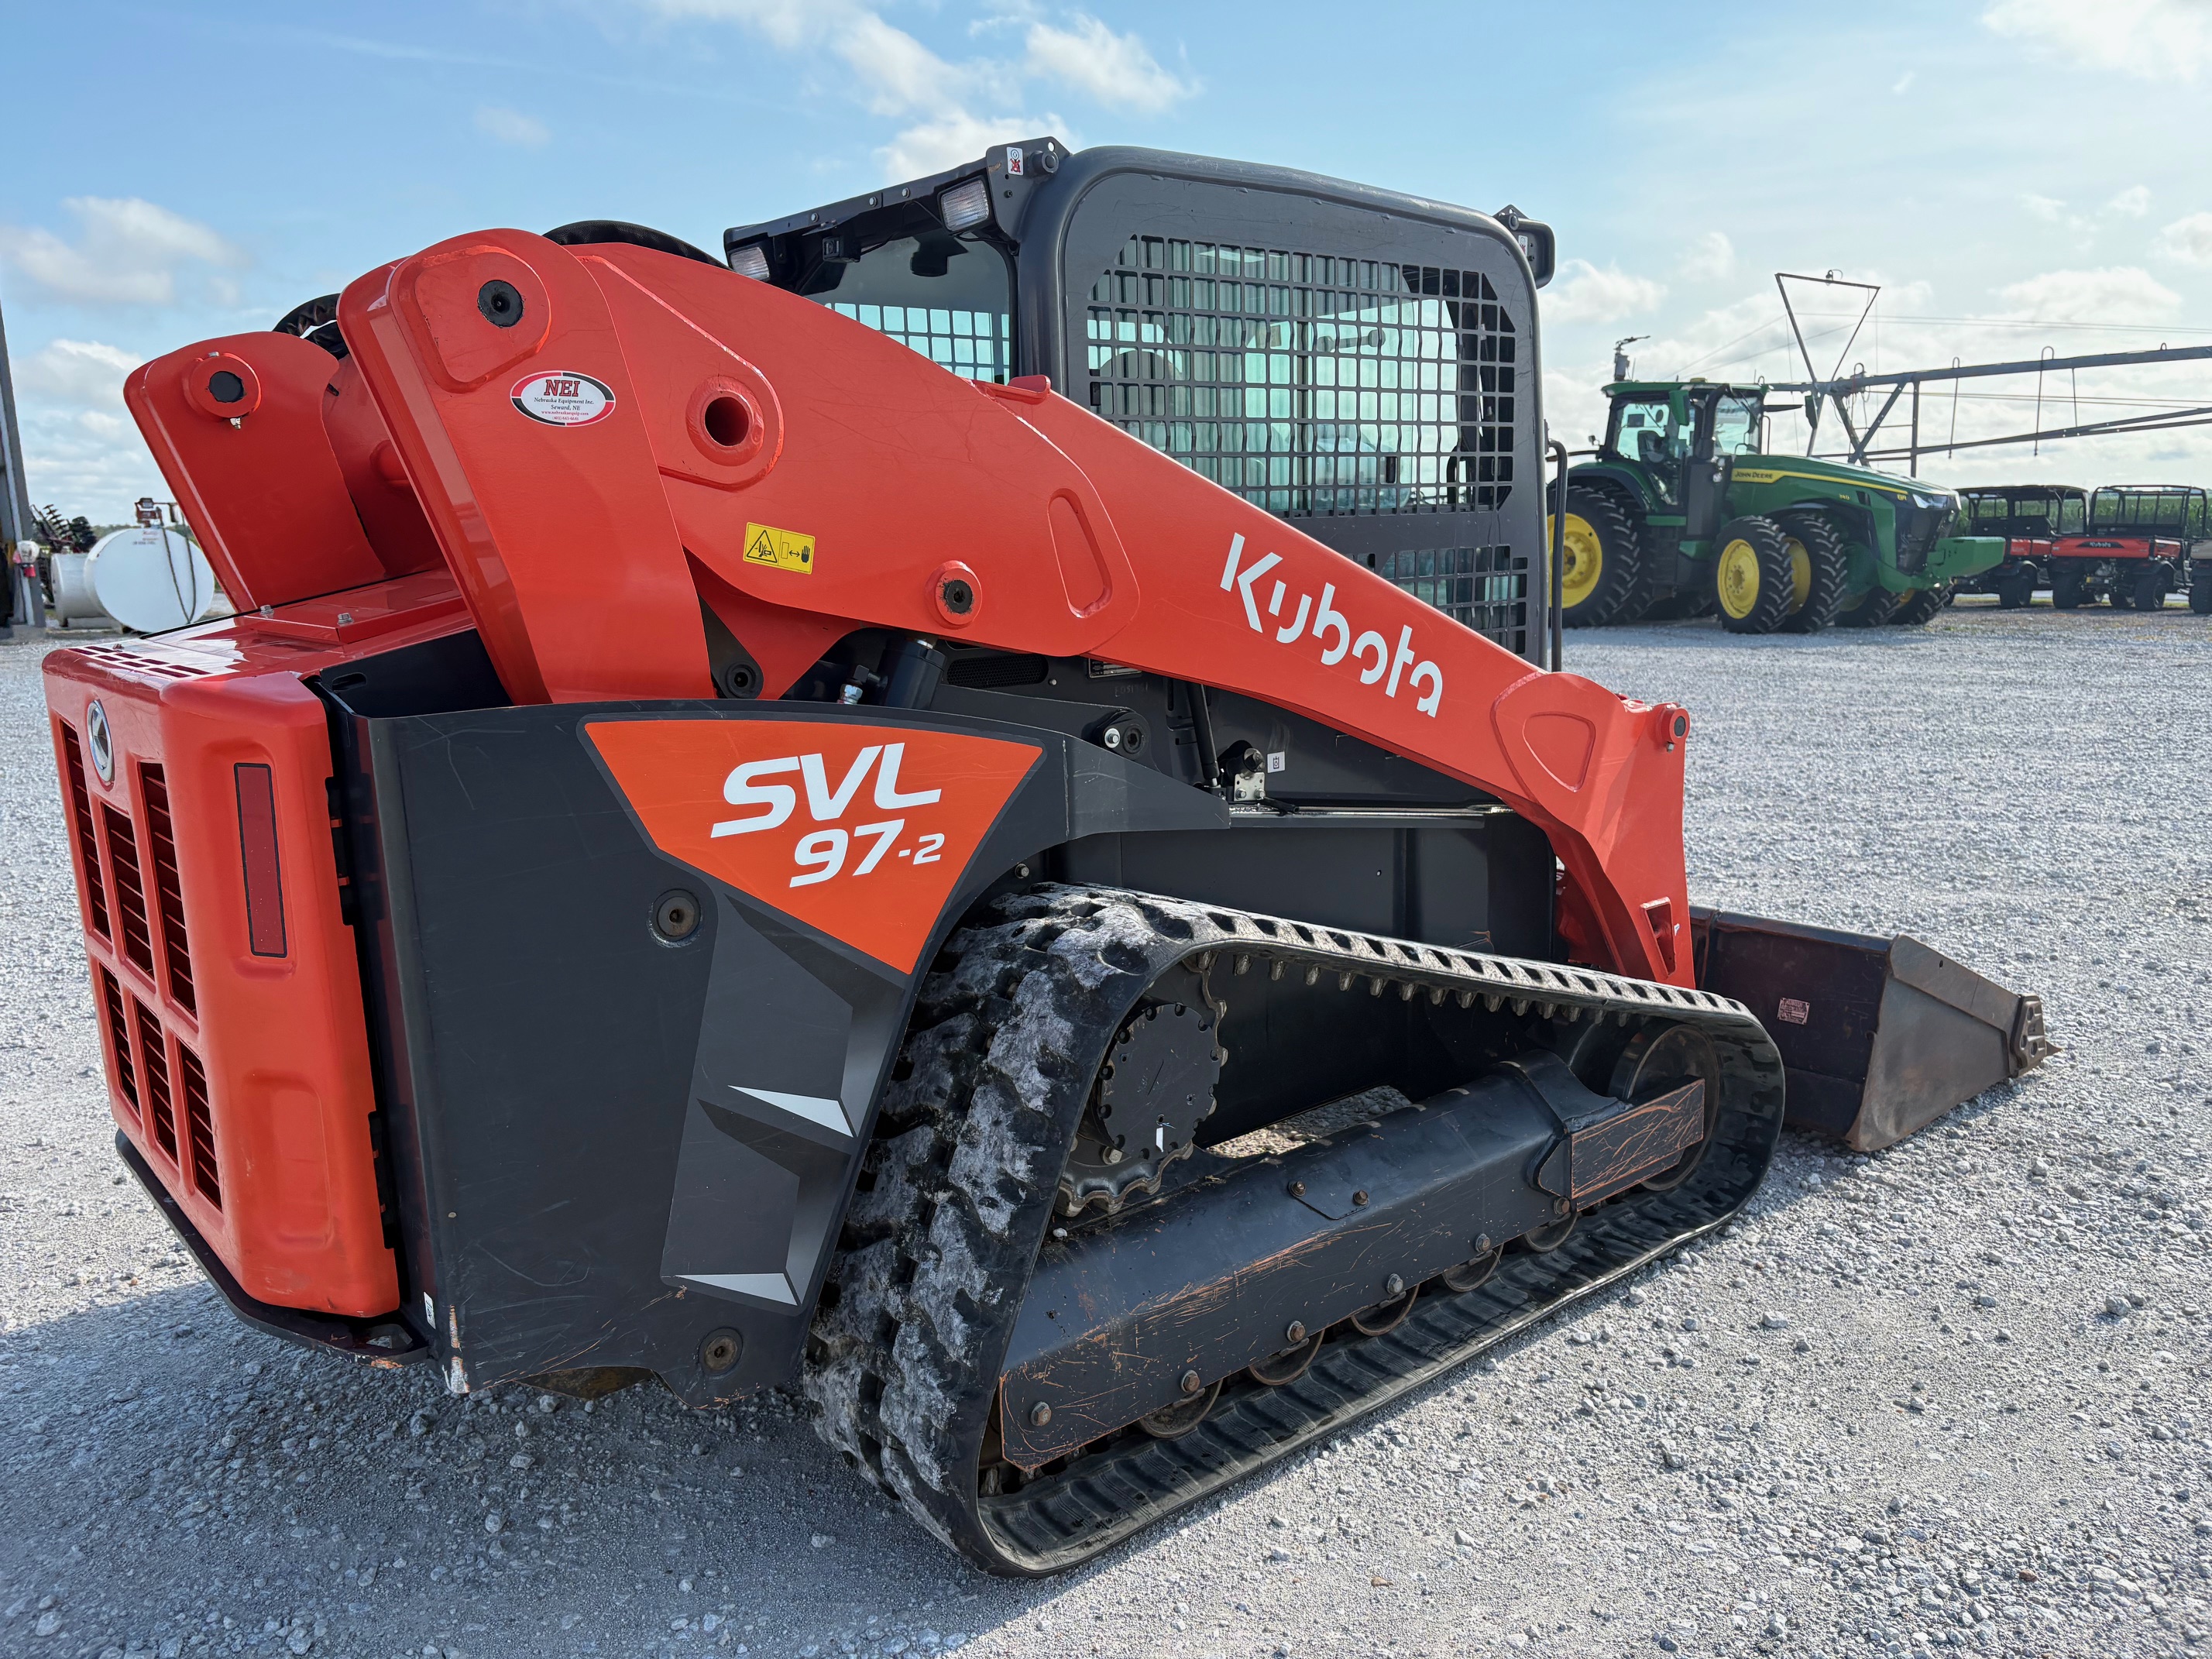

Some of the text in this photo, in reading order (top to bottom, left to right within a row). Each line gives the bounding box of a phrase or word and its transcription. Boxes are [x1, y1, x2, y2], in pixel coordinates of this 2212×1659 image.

[544, 380, 580, 397] NEI
[1220, 532, 1443, 718] Kubota
[710, 742, 942, 839] SVL
[789, 819, 945, 888] 97-2
